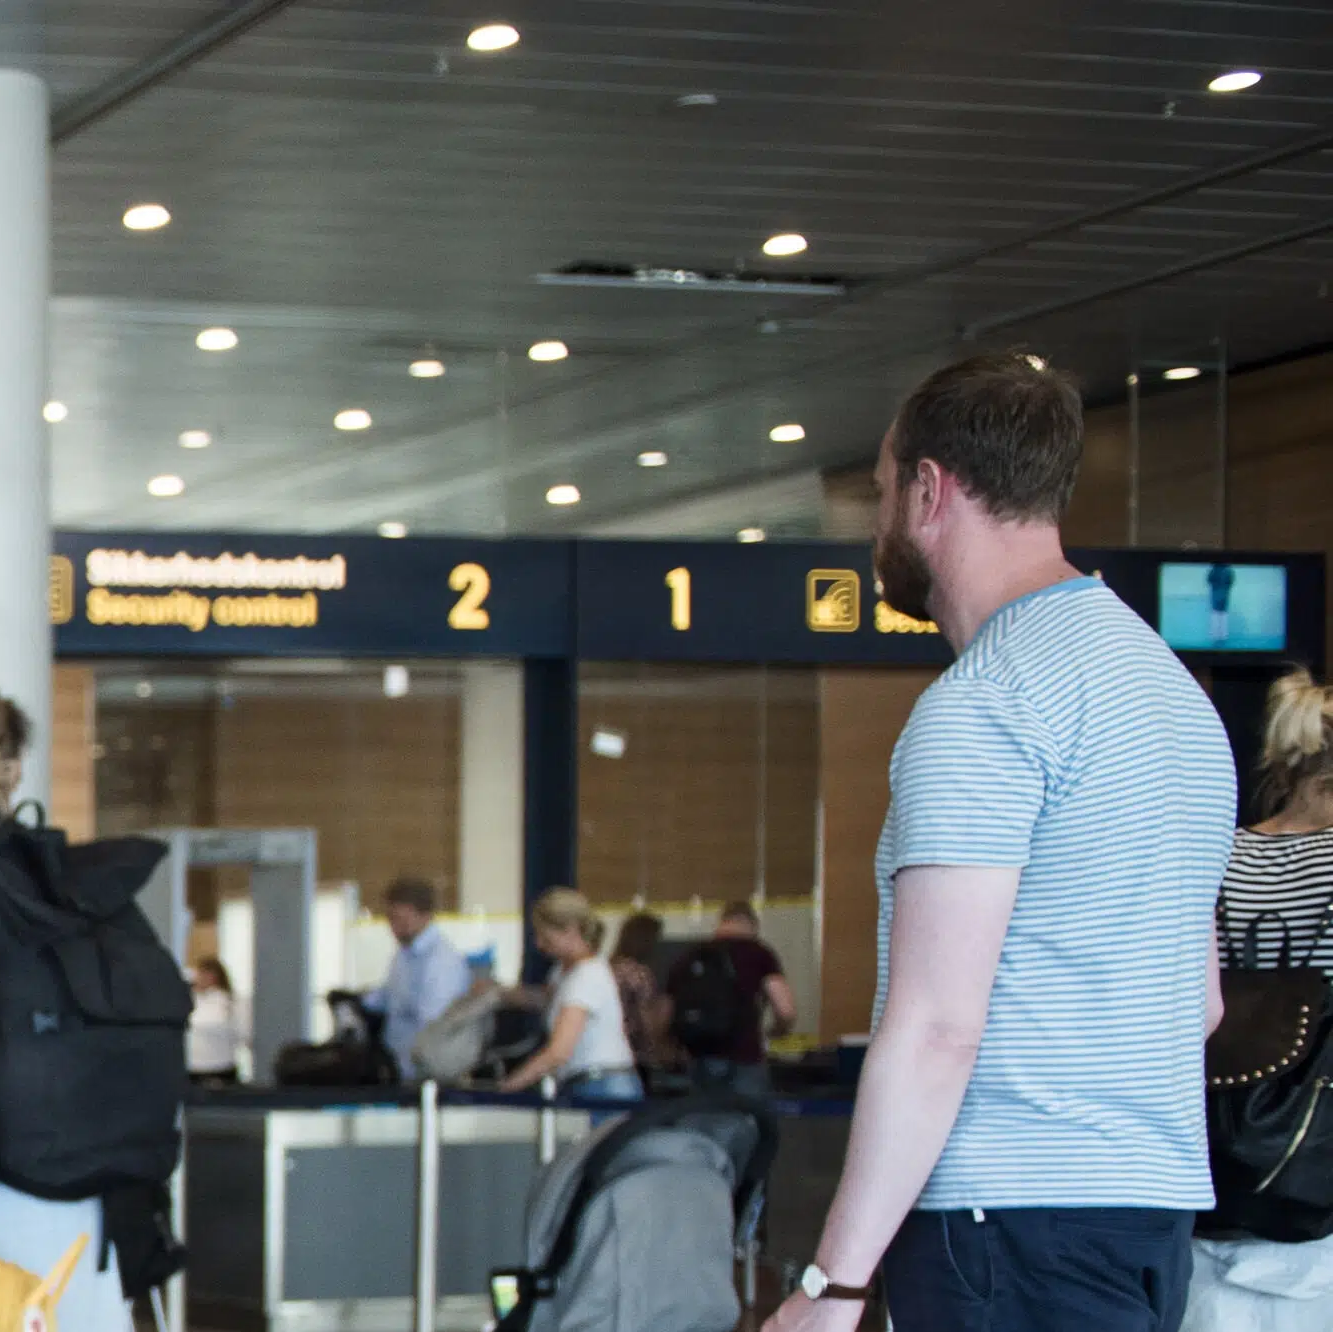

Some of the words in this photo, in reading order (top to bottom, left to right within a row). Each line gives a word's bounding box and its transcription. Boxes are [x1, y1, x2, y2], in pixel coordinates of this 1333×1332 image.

[86, 588, 210, 632] Security
[212, 591, 318, 627] control
[447, 562, 491, 630] 2
[665, 566, 691, 631] 1
